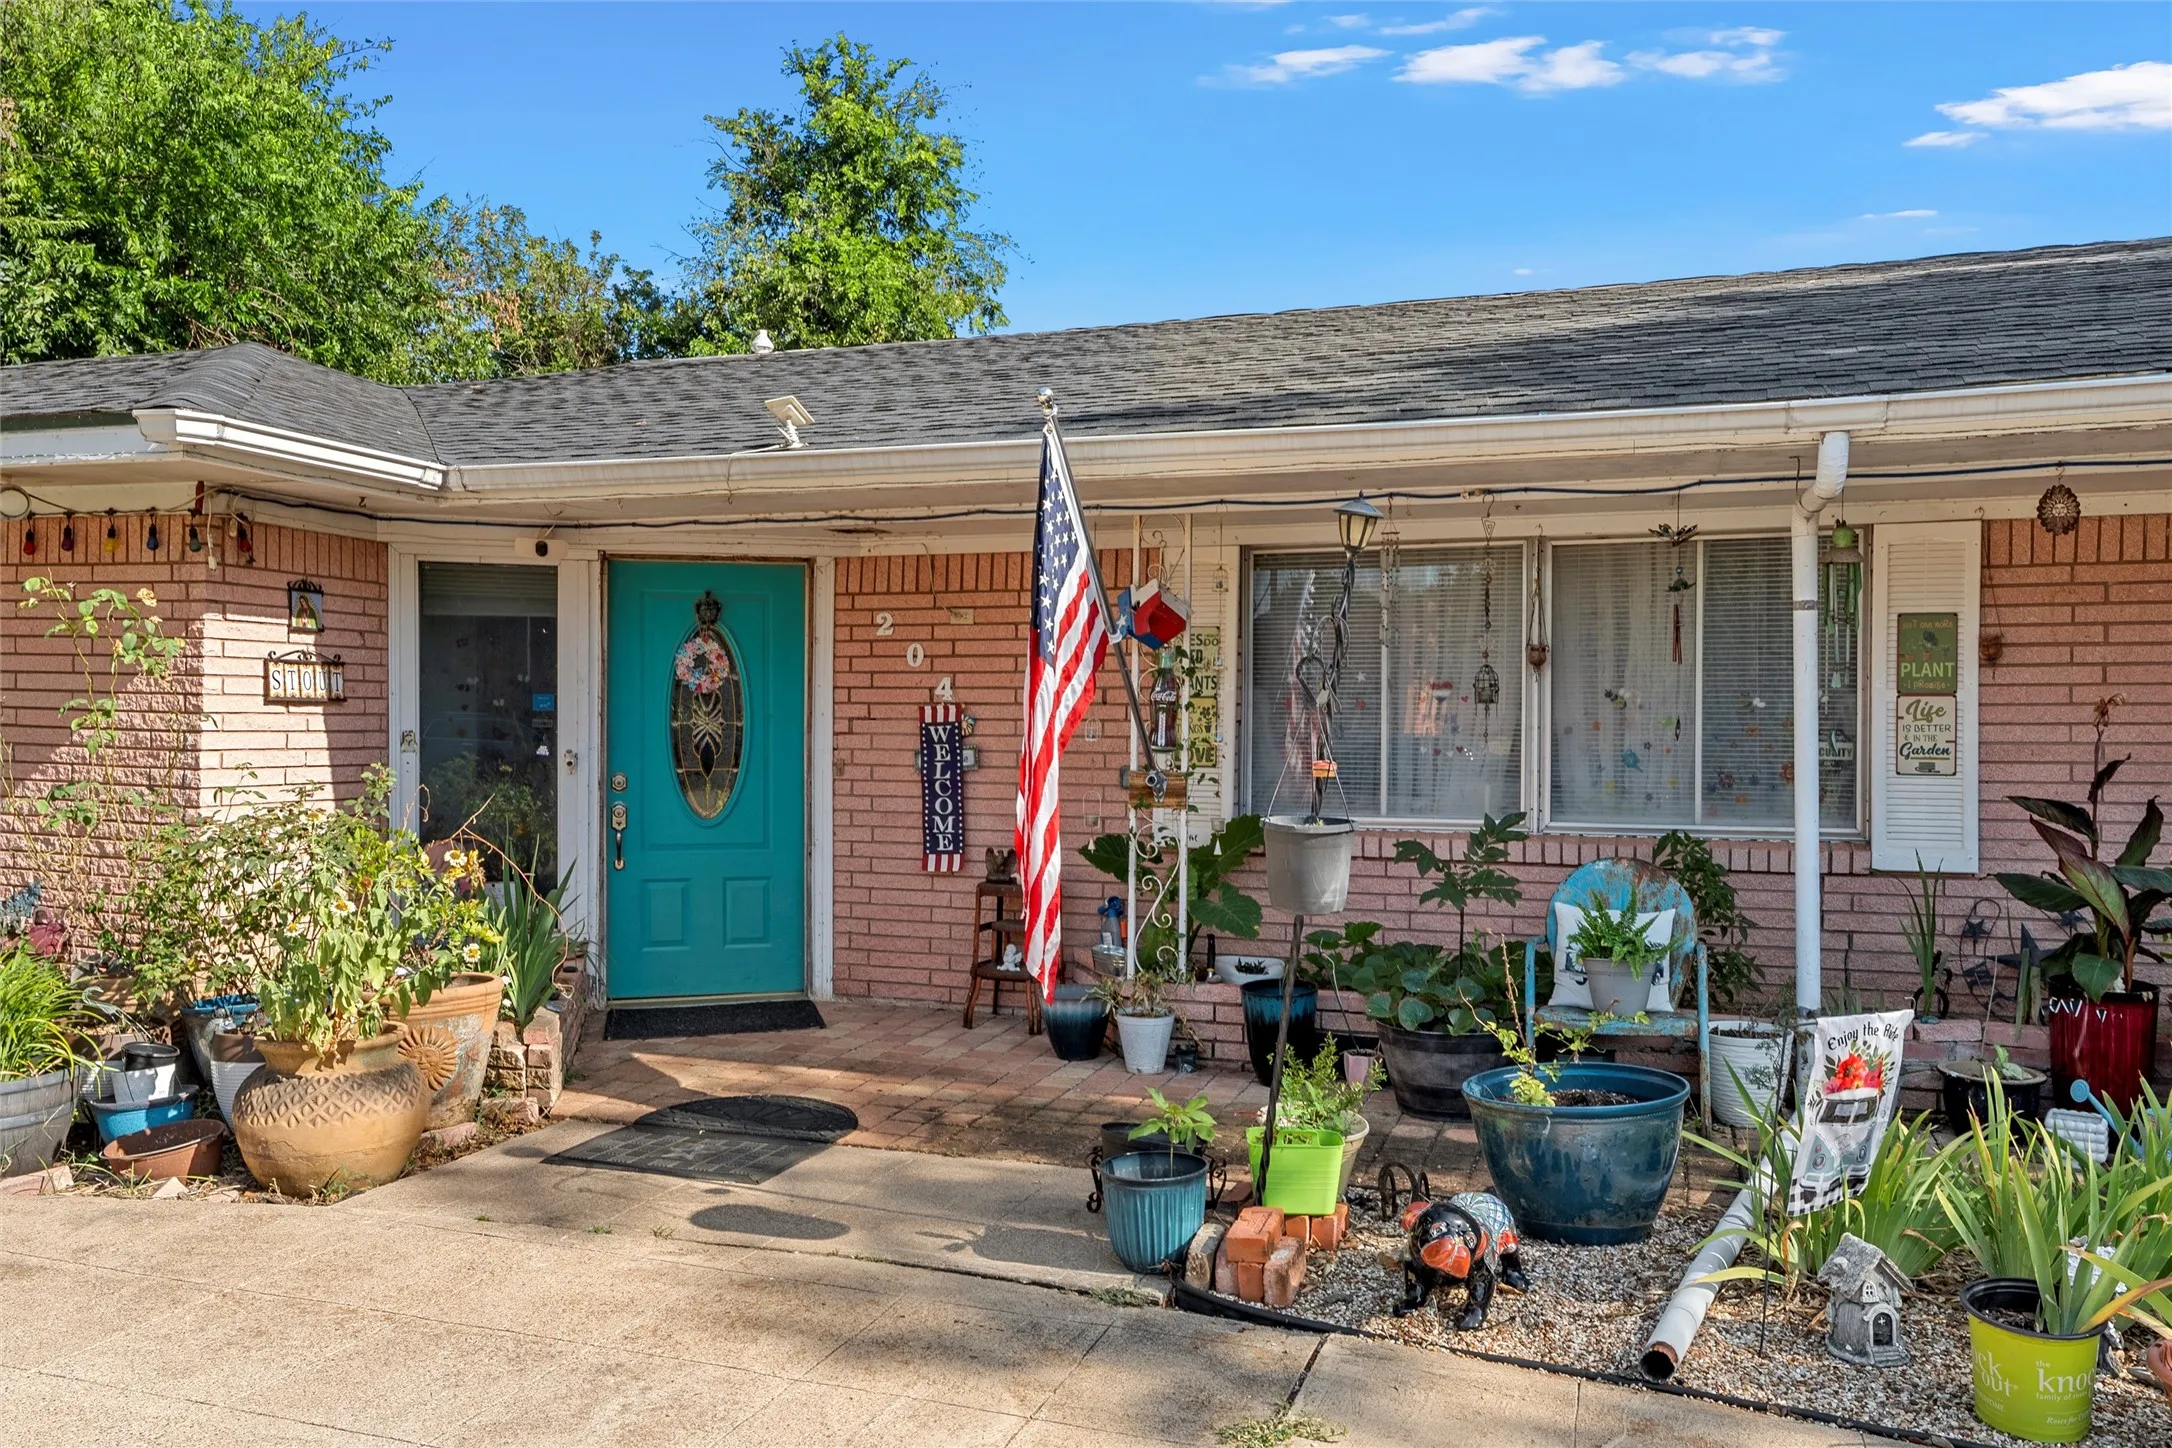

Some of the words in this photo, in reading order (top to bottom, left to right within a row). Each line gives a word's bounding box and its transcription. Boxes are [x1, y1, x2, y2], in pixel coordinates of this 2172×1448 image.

[1901, 662, 1955, 677] PLANT
[271, 669, 341, 692] STOUT
[1905, 699, 1947, 723] Life
[1902, 724, 1912, 732] IS
[1914, 724, 1952, 732] BETTER
[1922, 734, 1938, 742] THE
[1899, 742, 1951, 760] Garden
[928, 725, 955, 851] WELCOME
[1827, 1029, 1859, 1050] Enjoy
[1863, 1021, 1879, 1036] the
[1884, 1023, 1899, 1042] Ride
[2036, 1360, 2051, 1368] the
[2036, 1392, 2061, 1402] family
